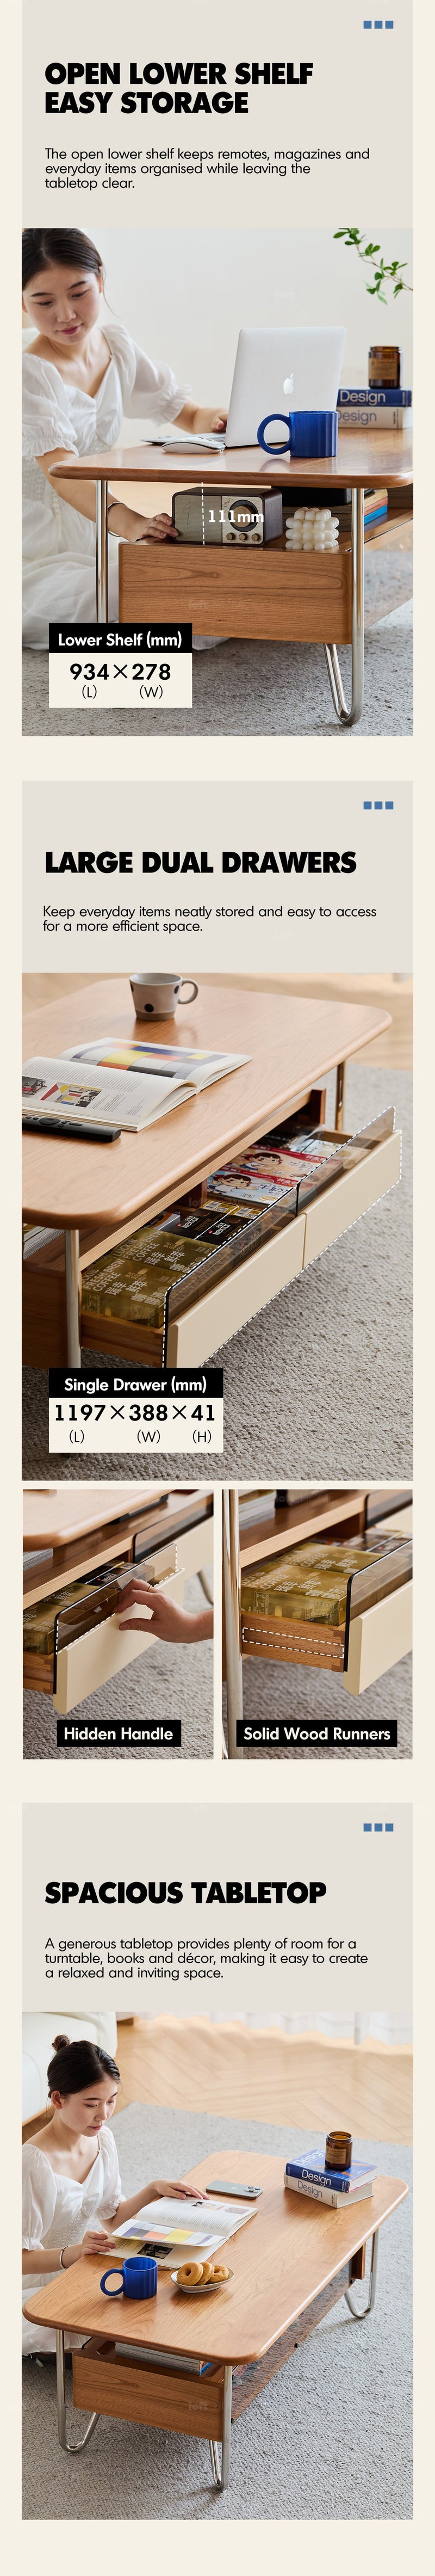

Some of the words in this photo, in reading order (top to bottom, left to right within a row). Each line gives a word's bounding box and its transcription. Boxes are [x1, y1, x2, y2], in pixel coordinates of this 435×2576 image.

[340, 390, 386, 405] Design
[122, 1242, 147, 1259] FRESH
[143, 1230, 163, 1243] BREW
[132, 1242, 160, 1261] COFFEE
[144, 1252, 165, 1265] 瑞幸
[83, 1272, 108, 1289] FRESH
[103, 1259, 126, 1272] BREW
[92, 1272, 121, 1292] COFFEE
[104, 1282, 127, 1296] 瑞幸
[259, 1573, 290, 1589] COFFEE
[293, 2150, 326, 2166] Design
[302, 2169, 332, 2186] Design
[297, 2180, 322, 2198] Design
